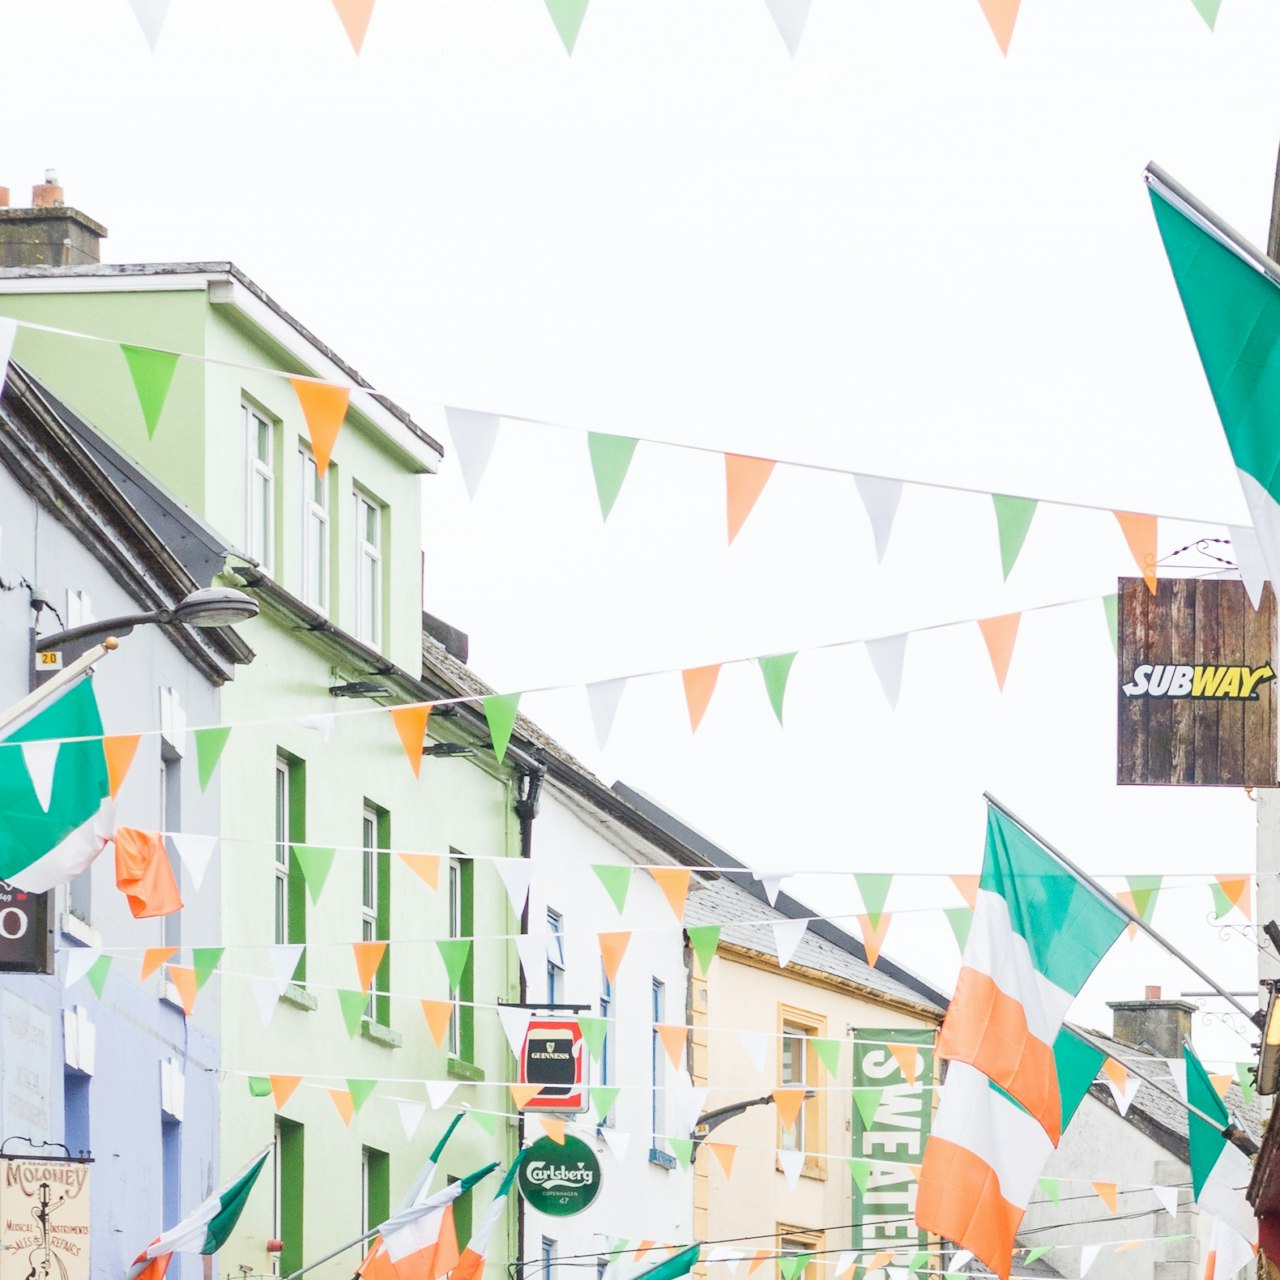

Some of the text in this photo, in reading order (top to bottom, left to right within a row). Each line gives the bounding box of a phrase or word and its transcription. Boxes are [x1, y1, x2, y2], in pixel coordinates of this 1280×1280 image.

[42, 653, 57, 664] 20
[1122, 661, 1278, 699] SUBWAY
[531, 1052, 570, 1061] GUINNESS
[6, 1163, 89, 1200] MOLONEY
[526, 1161, 594, 1187] Carlsberg
[542, 1190, 579, 1198] COPENHAGEN
